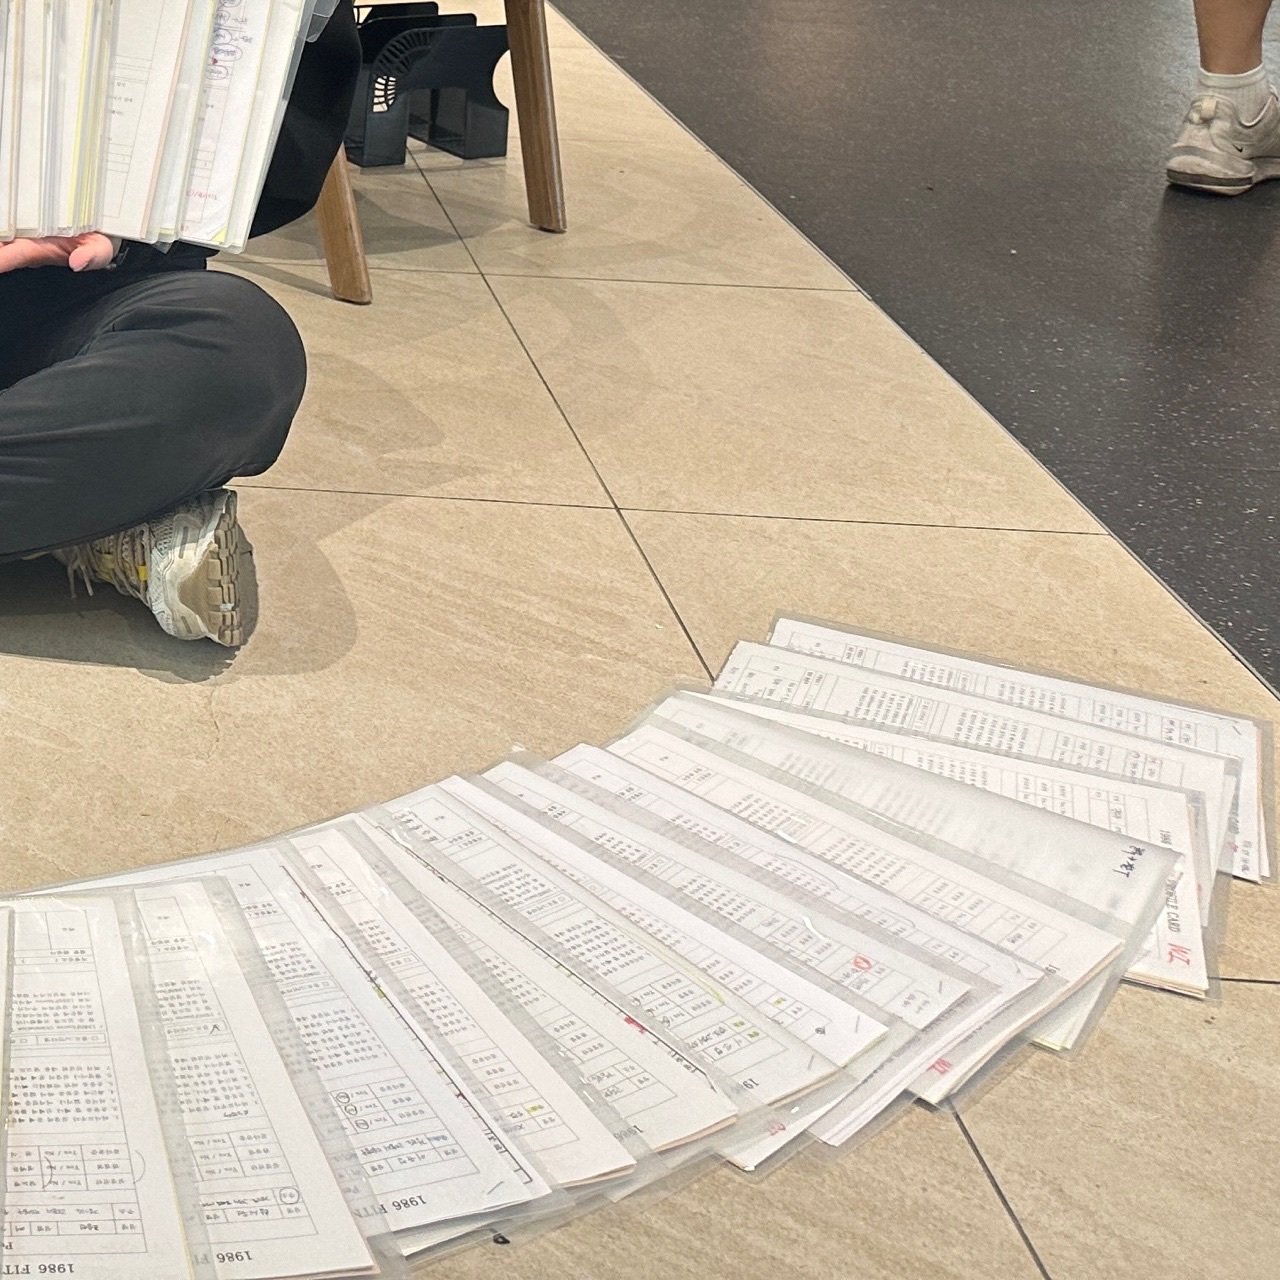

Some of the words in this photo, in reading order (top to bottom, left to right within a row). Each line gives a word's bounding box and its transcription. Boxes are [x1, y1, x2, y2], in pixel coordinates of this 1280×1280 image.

[392, 1195, 427, 1211] 1986
[216, 1251, 252, 1263] 1986
[38, 1263, 75, 1274] 1986
